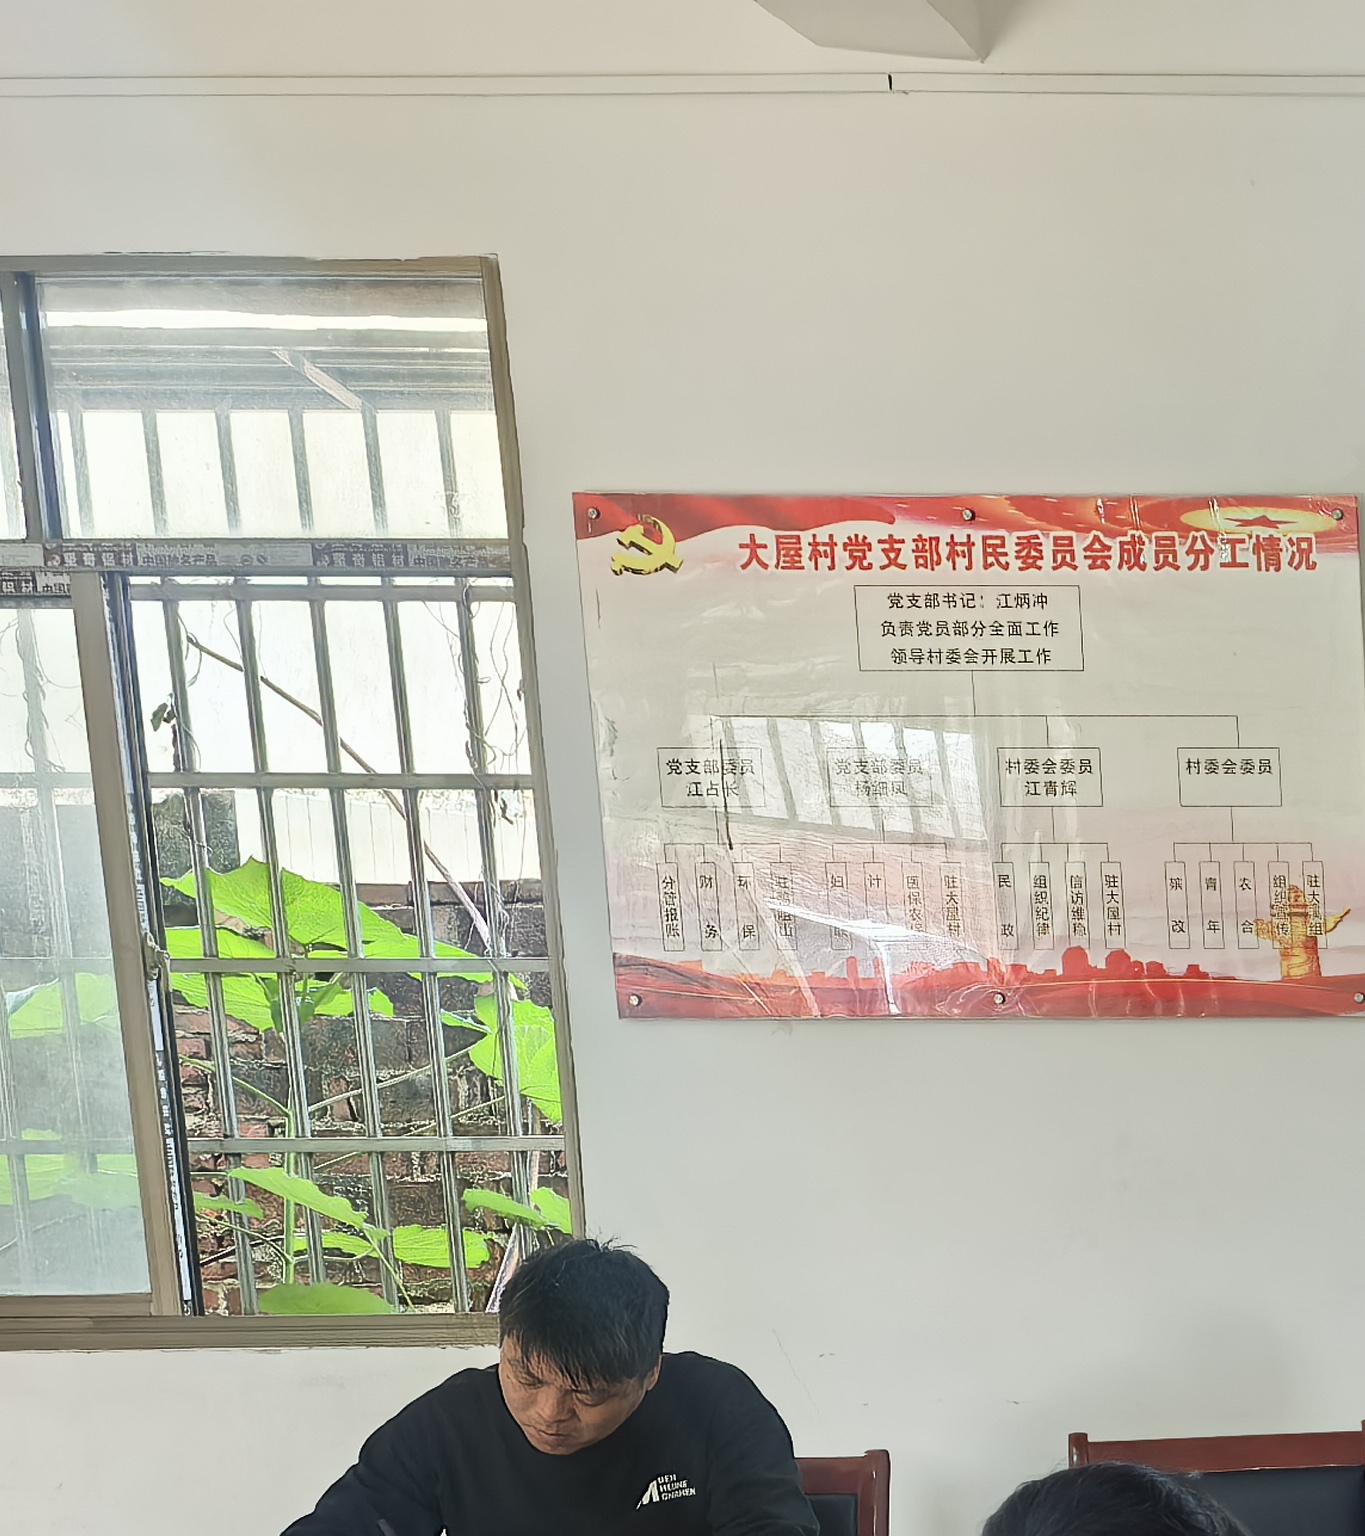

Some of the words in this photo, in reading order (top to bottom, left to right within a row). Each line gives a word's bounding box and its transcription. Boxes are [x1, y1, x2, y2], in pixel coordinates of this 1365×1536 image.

[738, 533, 1318, 572] 大屋村党支部村民委员会成员分工情况
[880, 619, 1060, 638] 负责党员部分全面工作
[890, 647, 1052, 665] 领导村委会开展工作
[665, 758, 756, 776] 党支部委员
[834, 758, 925, 776] 党支部委员
[1004, 758, 1094, 775] 村委会委员
[1185, 758, 1274, 775] 村委会委员
[1023, 780, 1078, 797] 江青辉
